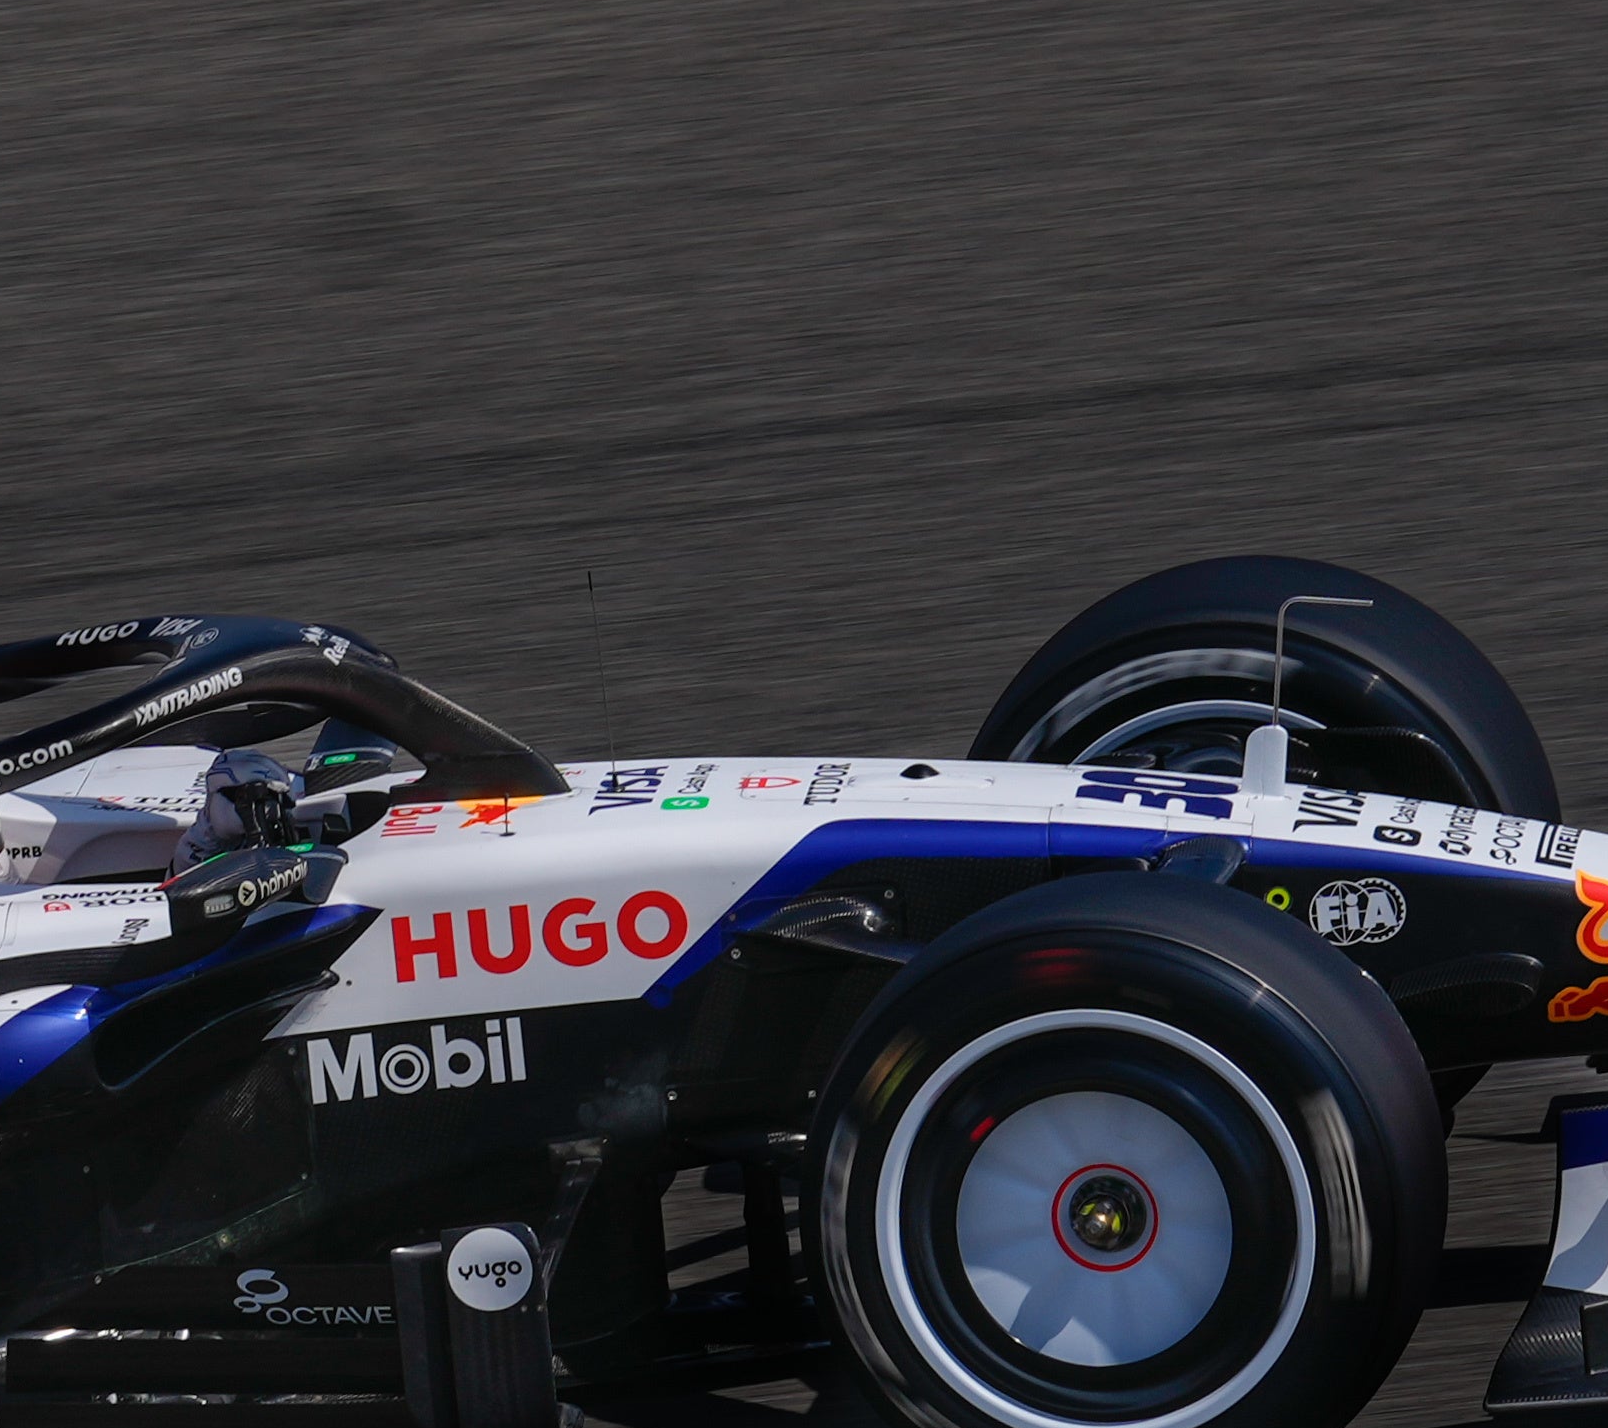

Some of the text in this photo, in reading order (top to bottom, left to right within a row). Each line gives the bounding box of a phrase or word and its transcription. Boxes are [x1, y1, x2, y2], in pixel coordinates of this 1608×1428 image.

[56, 620, 139, 648] HUGO
[149, 616, 206, 639] VISA
[587, 764, 669, 817] VISA
[802, 762, 852, 807] TUDOR
[1073, 770, 1242, 821] 30
[380, 804, 446, 838] Bull
[390, 889, 688, 983] HUGO
[305, 1017, 528, 1105] Mobil
[457, 1259, 523, 1290] yugo
[266, 1304, 397, 1328] OCTAVE
